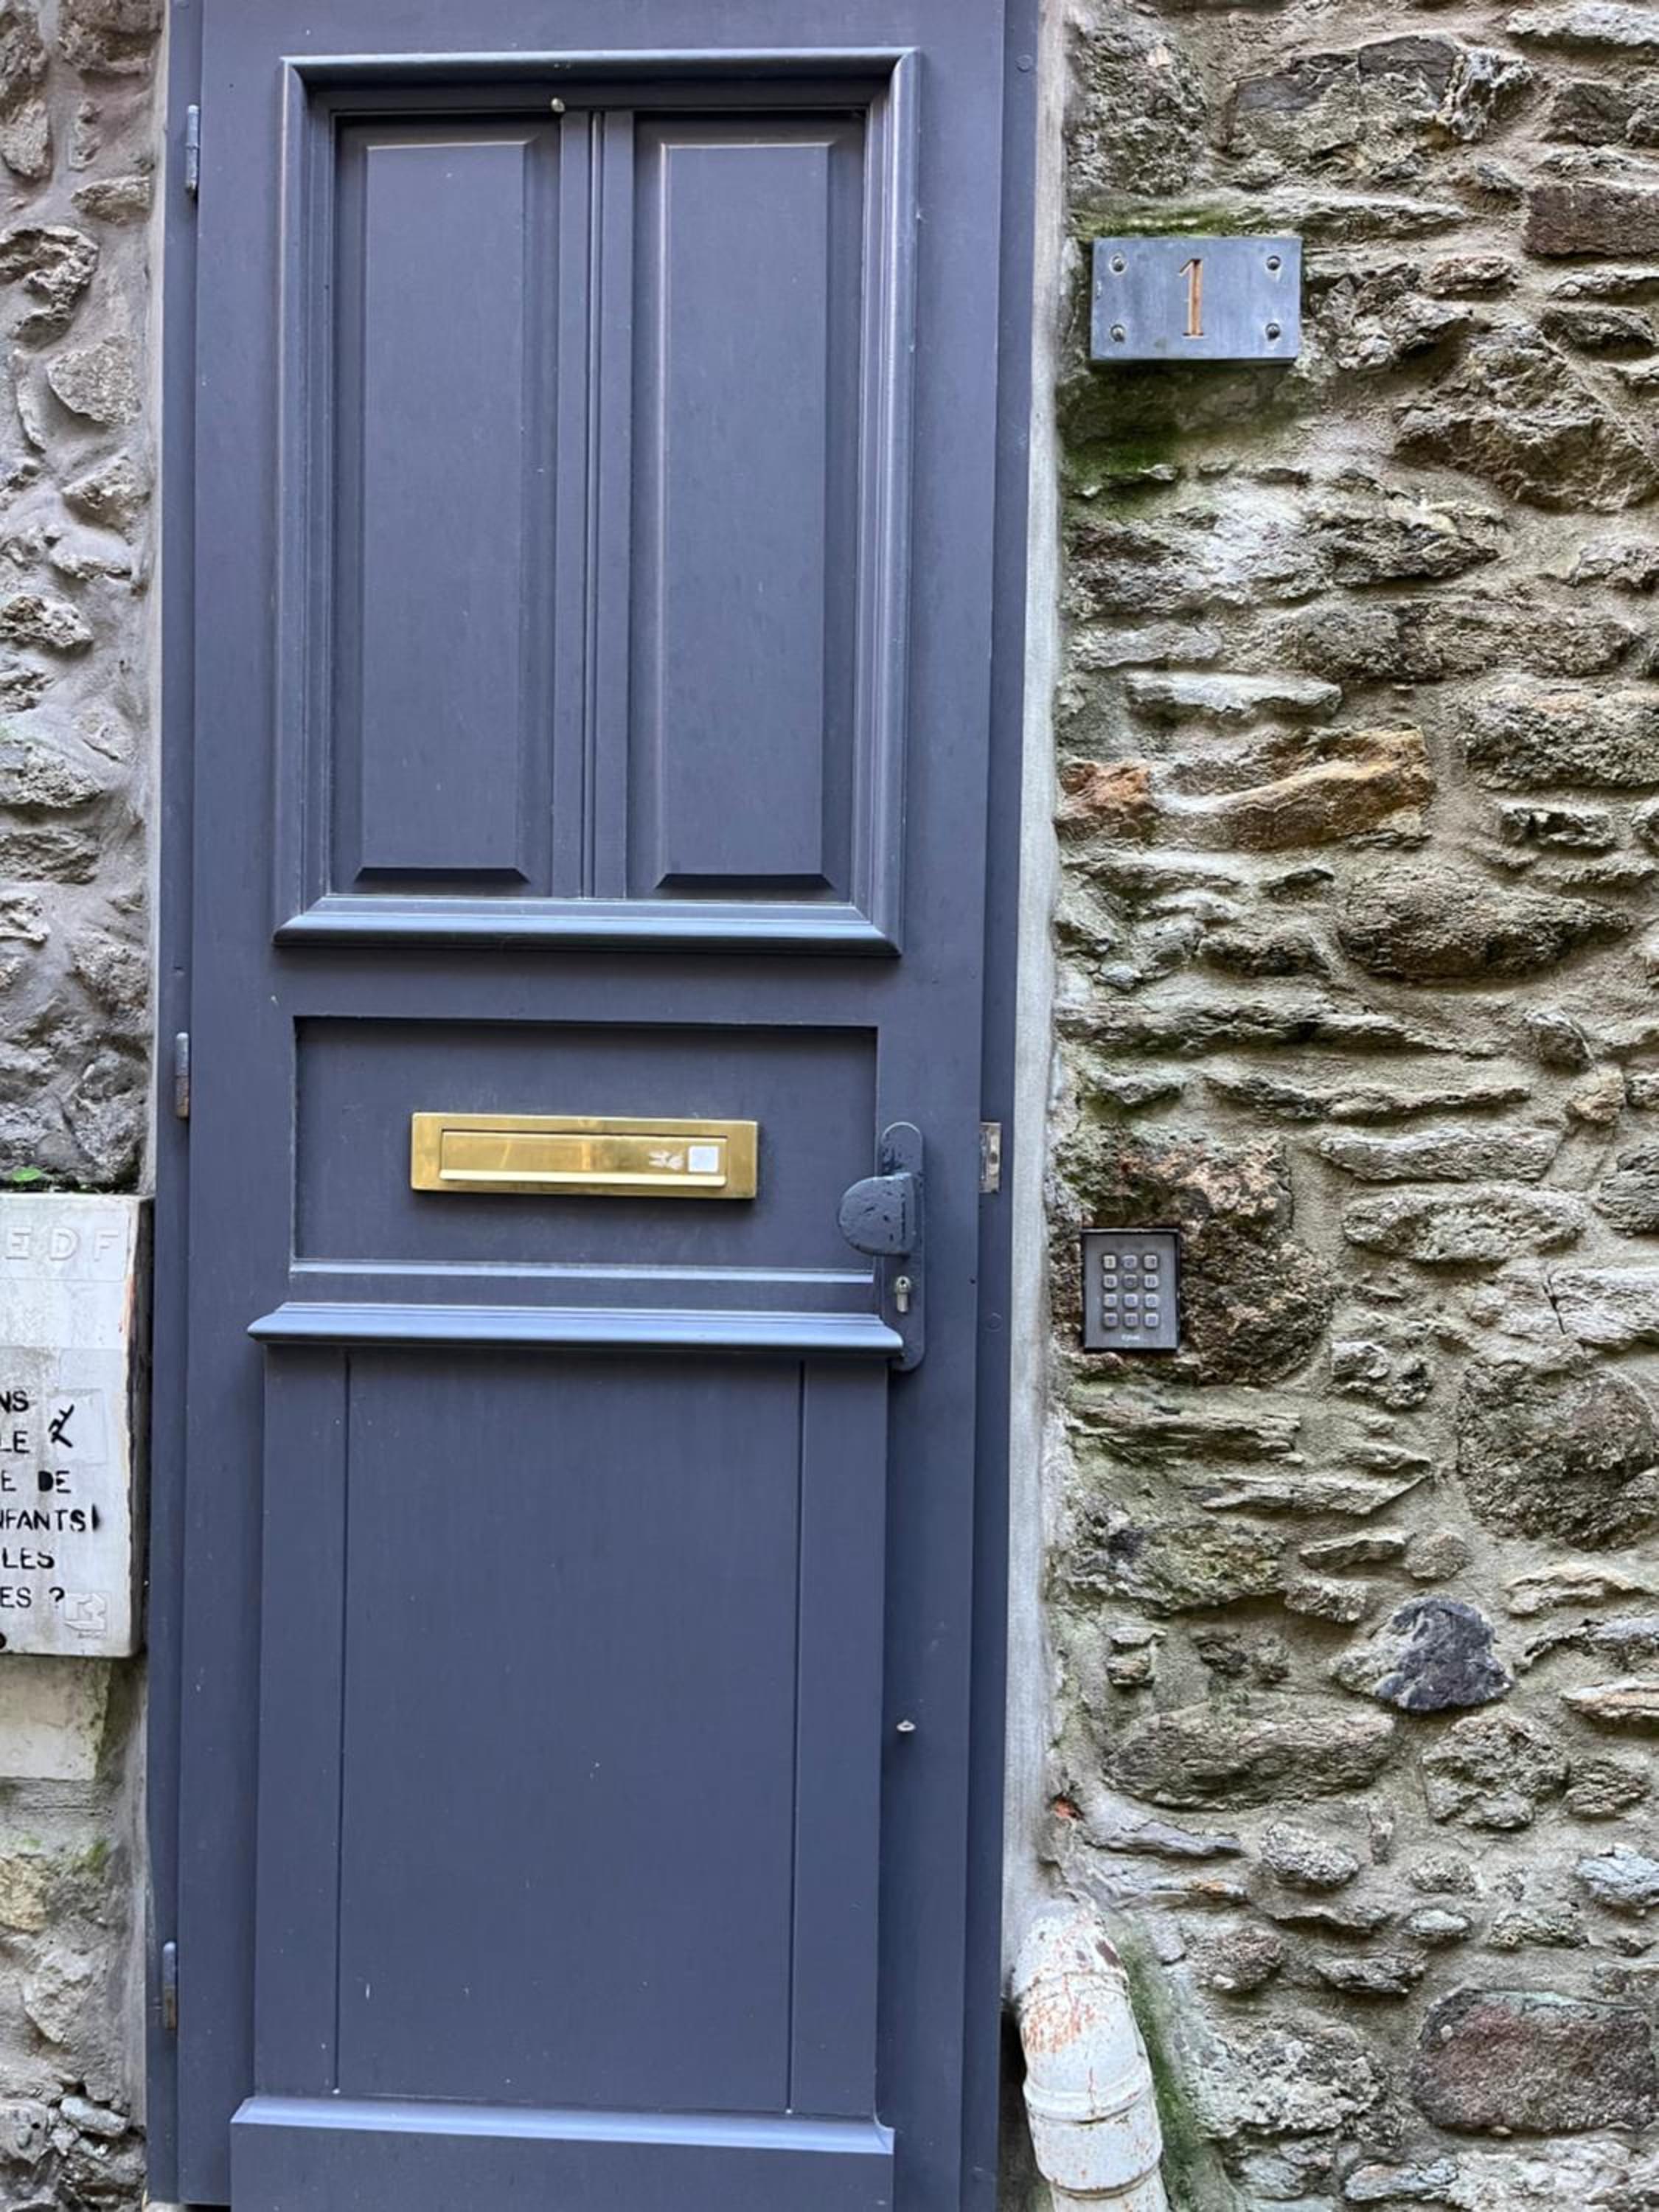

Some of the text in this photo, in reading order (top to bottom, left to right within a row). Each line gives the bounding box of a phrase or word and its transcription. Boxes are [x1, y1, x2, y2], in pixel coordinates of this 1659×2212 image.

[1178, 257, 1205, 338] 1
[5, 1228, 119, 1262] EDF
[38, 1470, 72, 1493] DE
[2, 1547, 55, 1570] LES
